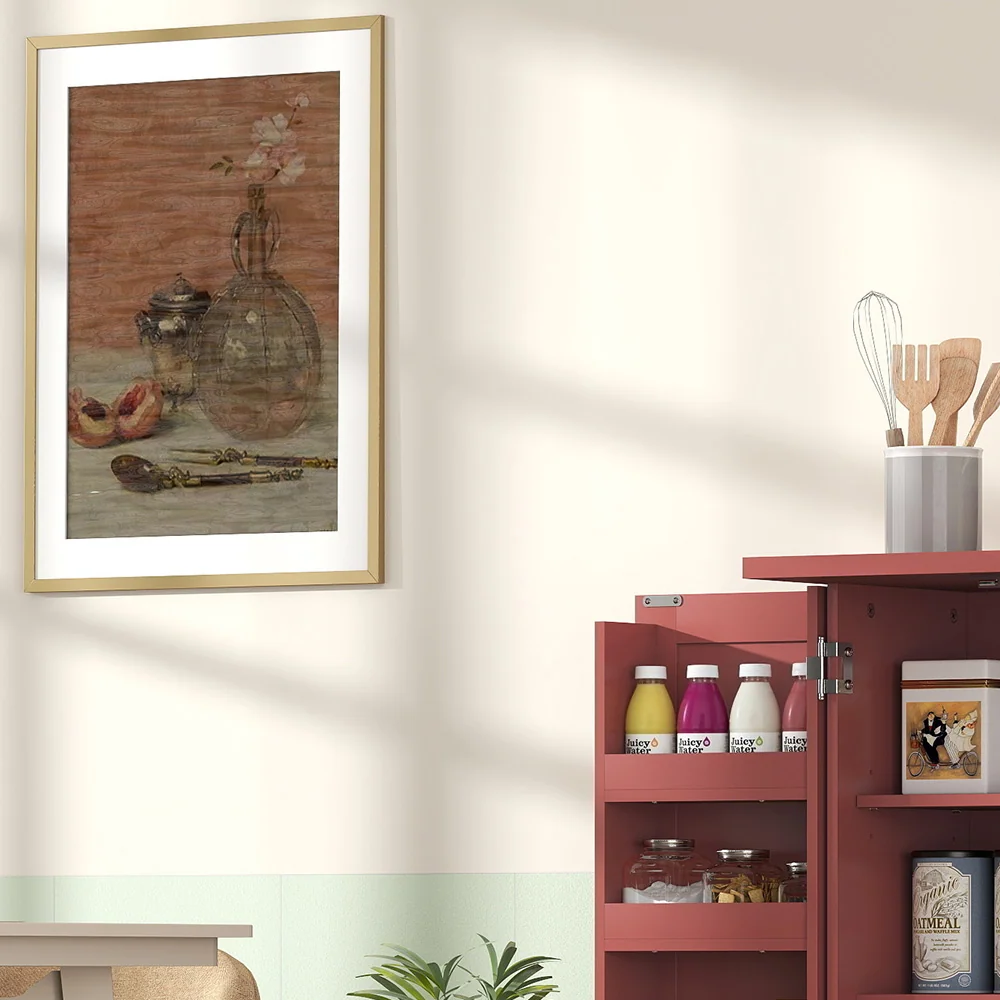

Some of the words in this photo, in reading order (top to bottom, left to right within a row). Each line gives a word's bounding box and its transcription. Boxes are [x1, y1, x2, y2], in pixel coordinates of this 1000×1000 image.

[626, 739, 651, 748] Juicy
[679, 738, 702, 748] Juicy
[731, 737, 755, 746] Juicy
[784, 736, 807, 745] Juicy
[914, 917, 961, 929] OATMEAL
